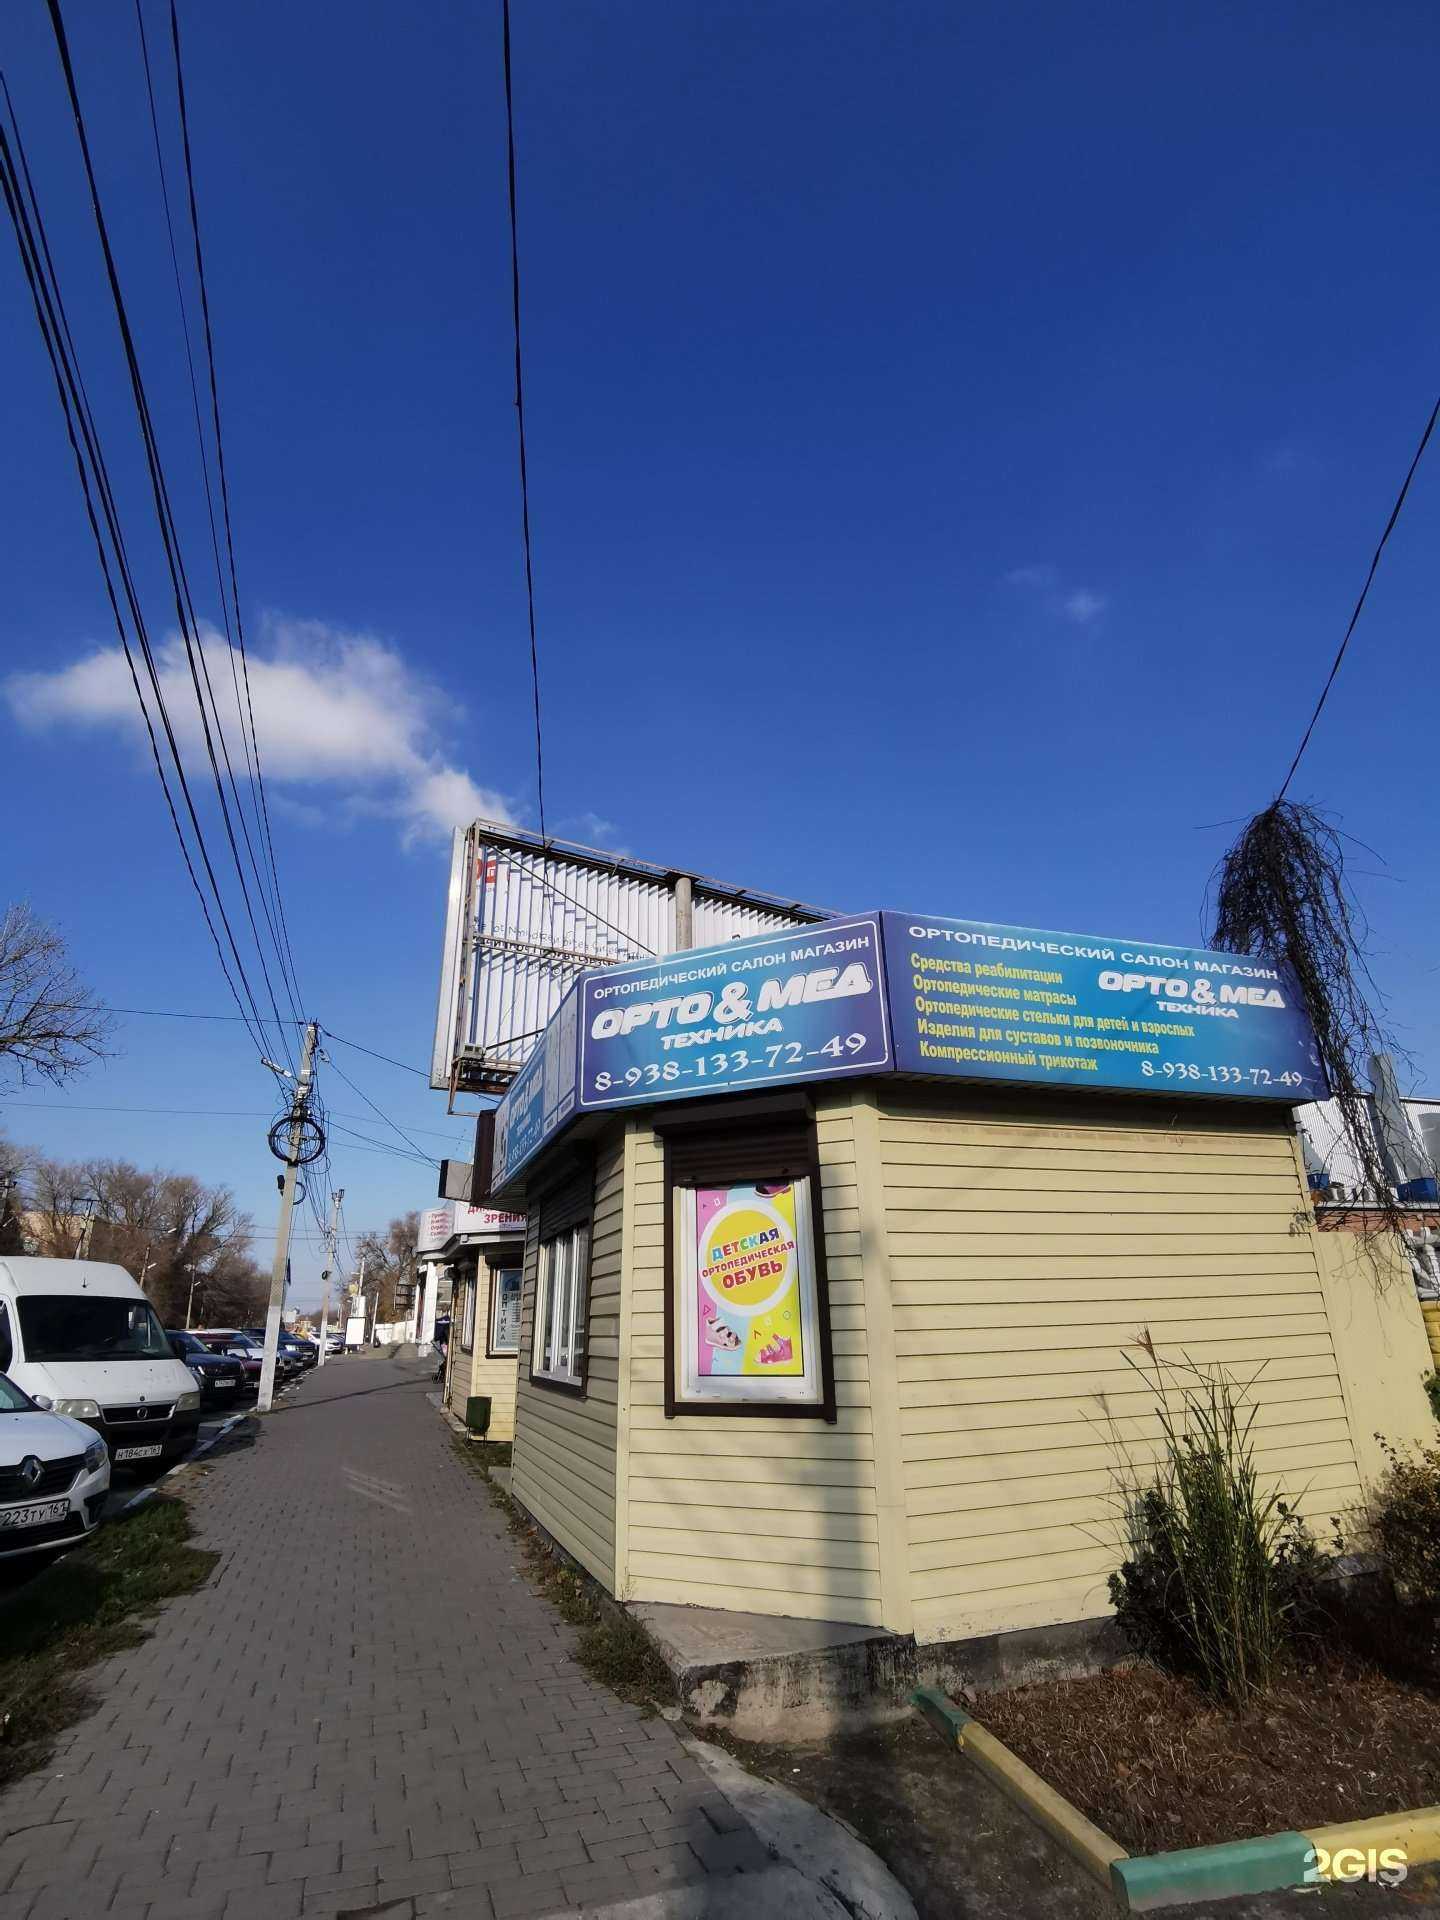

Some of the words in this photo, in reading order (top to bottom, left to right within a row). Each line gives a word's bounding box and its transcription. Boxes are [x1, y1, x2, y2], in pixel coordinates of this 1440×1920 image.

[594, 962, 727, 999] ОРТОПЕДИЧЕСКИЙ
[731, 953, 786, 973] САЛОН
[790, 936, 870, 961] МАГАЗИН
[909, 926, 1115, 961] ОРТОПЕДИЧЕСКИЙ
[1120, 952, 1189, 970] САЛОН
[1194, 961, 1278, 980] МАГАЗИН
[910, 952, 971, 974] Средства
[975, 963, 1063, 984] реабилитации
[591, 991, 714, 1040] ОРТО
[713, 981, 753, 1025] &
[757, 962, 873, 1012] МЕД
[913, 974, 1021, 1000] Ортопедические
[1024, 989, 1077, 1006] матрасы
[1099, 970, 1189, 998] ОРТО
[1191, 979, 1217, 1005] &
[1219, 985, 1286, 1009] МЕД
[915, 996, 1019, 1021] Ортопедические
[1023, 1009, 1071, 1026] стельки
[1073, 1015, 1094, 1030] для
[1097, 1016, 1129, 1031] детей
[1132, 1021, 1140, 1031] и
[1141, 1022, 1195, 1037] взрослых
[1156, 1001, 1239, 1019] ТЕХНИКА
[660, 1017, 784, 1050] ТЕХНИКА
[917, 1018, 976, 1039] Изделия
[979, 1027, 1002, 1041] для
[1006, 1029, 1061, 1046] суставов
[1064, 1035, 1072, 1046] и
[1075, 1036, 1159, 1055] позвоночника
[594, 1032, 867, 1091] 8-938-133-72-49
[920, 1040, 1037, 1066] Компрессионный
[1039, 1054, 1098, 1071] трикотаж
[1141, 1061, 1302, 1087] 8-938-133-72-49
[484, 1212, 527, 1224] ЗРЕНИЯ
[702, 1240, 795, 1278] ОРТОПЕДИЧЕСКАЯ
[712, 1227, 780, 1262] ДЕТСКАЯ
[723, 1260, 783, 1289] ОБУВЬ
